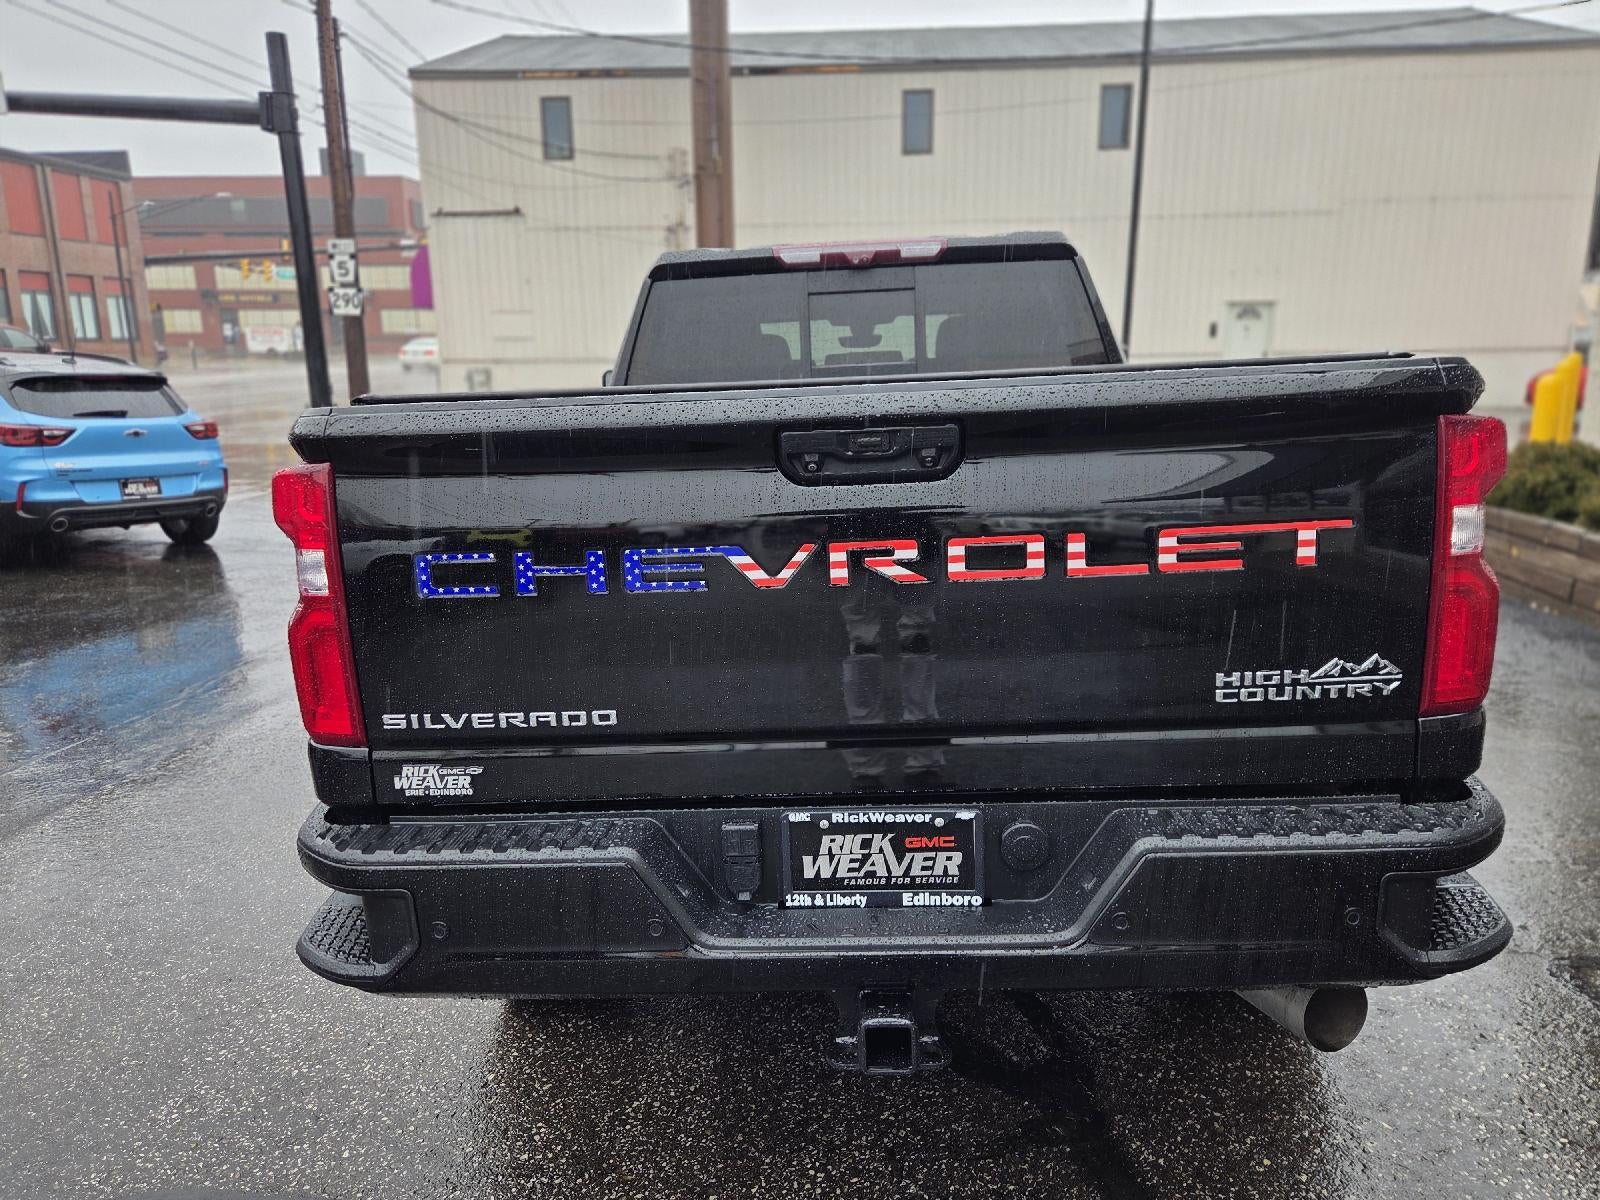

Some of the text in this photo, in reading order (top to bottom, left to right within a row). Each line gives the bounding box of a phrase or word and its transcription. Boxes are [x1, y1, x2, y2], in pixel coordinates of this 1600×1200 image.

[337, 261, 350, 278] 5
[332, 291, 361, 309] 290
[414, 519, 1355, 598] CHEVROLET
[1215, 669, 1310, 687] HIGH
[1215, 680, 1402, 703] COUNTRY
[382, 710, 618, 730] SILVERADO
[401, 764, 442, 778] RICK
[393, 774, 472, 790] WEAVER
[405, 788, 474, 797] ERIE EDINBORO
[788, 812, 811, 822] GMC
[831, 812, 933, 824] RickWeaver
[818, 833, 956, 855] RICK GMC
[802, 851, 963, 879] WEAVER
[844, 876, 960, 886] FAMOUS FOR SERVICE
[785, 894, 868, 908] 12th & Liberty
[902, 892, 983, 907] Edinboro
